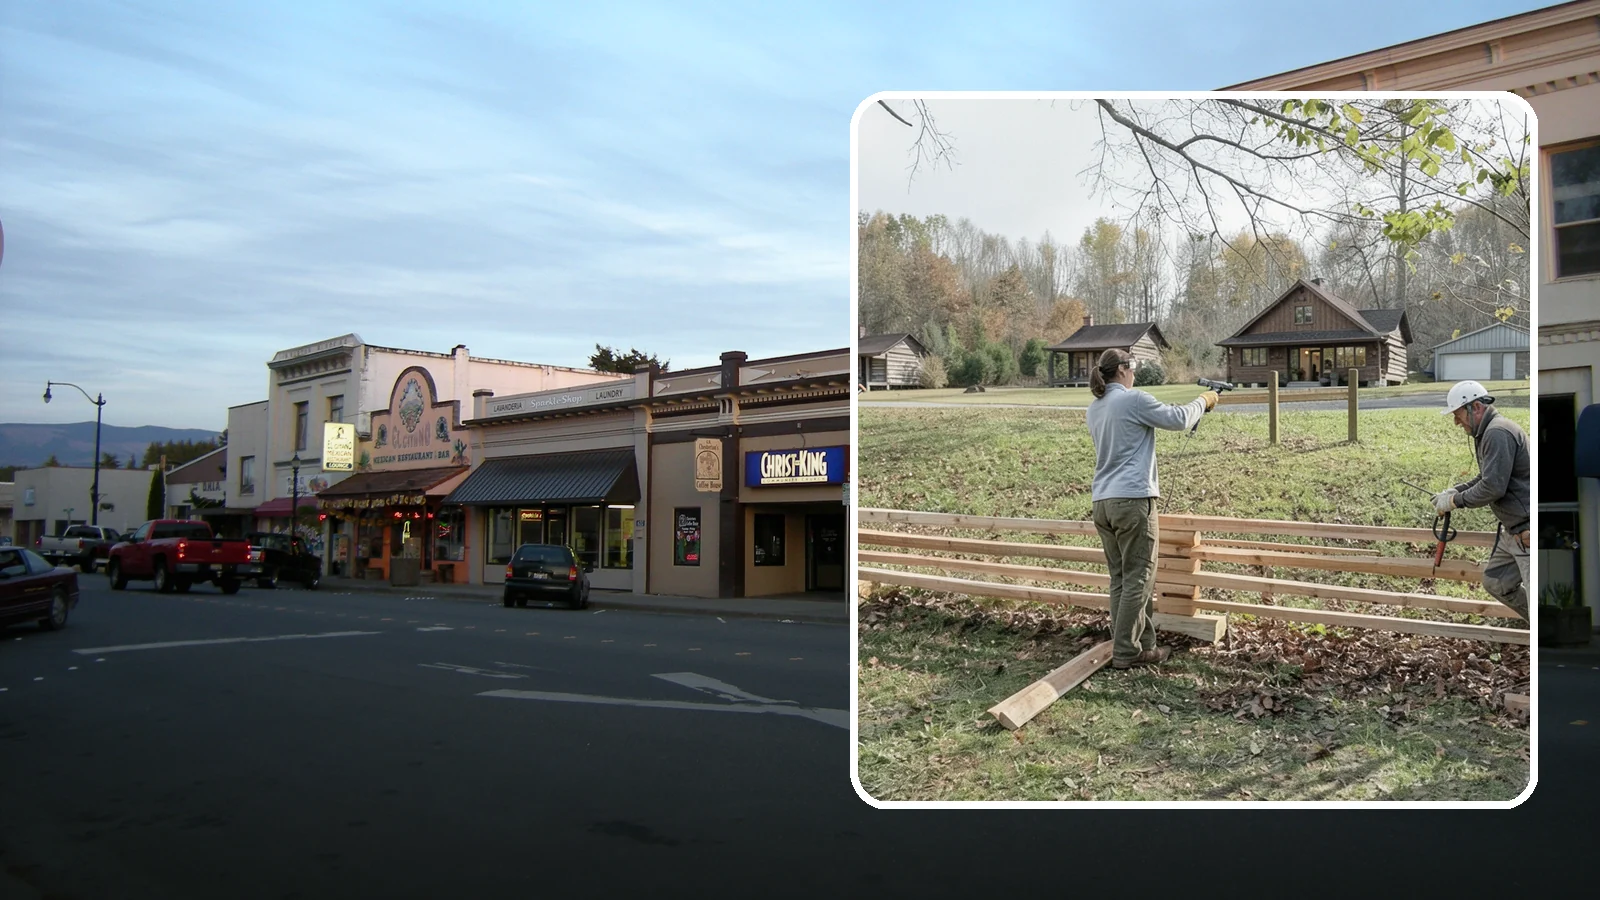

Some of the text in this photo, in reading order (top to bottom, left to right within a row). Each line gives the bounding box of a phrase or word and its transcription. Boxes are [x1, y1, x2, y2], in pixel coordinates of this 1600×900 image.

[493, 388, 624, 412] LAVANDERIA Sparkle Shop LAUNDRY
[373, 454, 396, 464] MEXICAN
[397, 451, 433, 462] RESTAURANT
[438, 450, 450, 459] BAR
[761, 450, 827, 478] CHRIST KING
